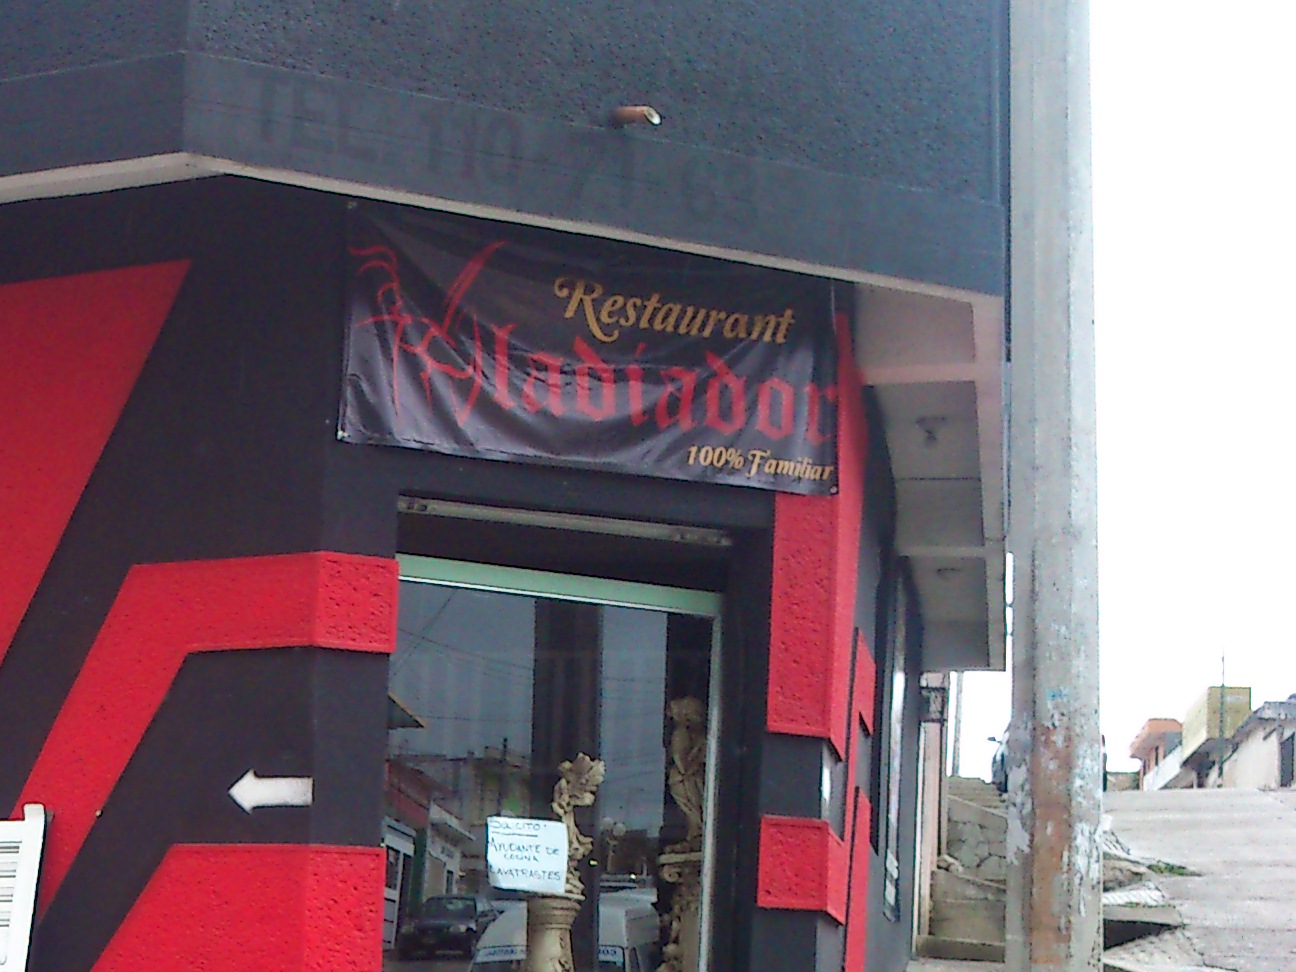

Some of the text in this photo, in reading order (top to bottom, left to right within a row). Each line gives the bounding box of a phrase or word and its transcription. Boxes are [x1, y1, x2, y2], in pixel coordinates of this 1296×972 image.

[554, 276, 794, 343] Restaurant
[687, 445, 834, 481] 100% Familiar
